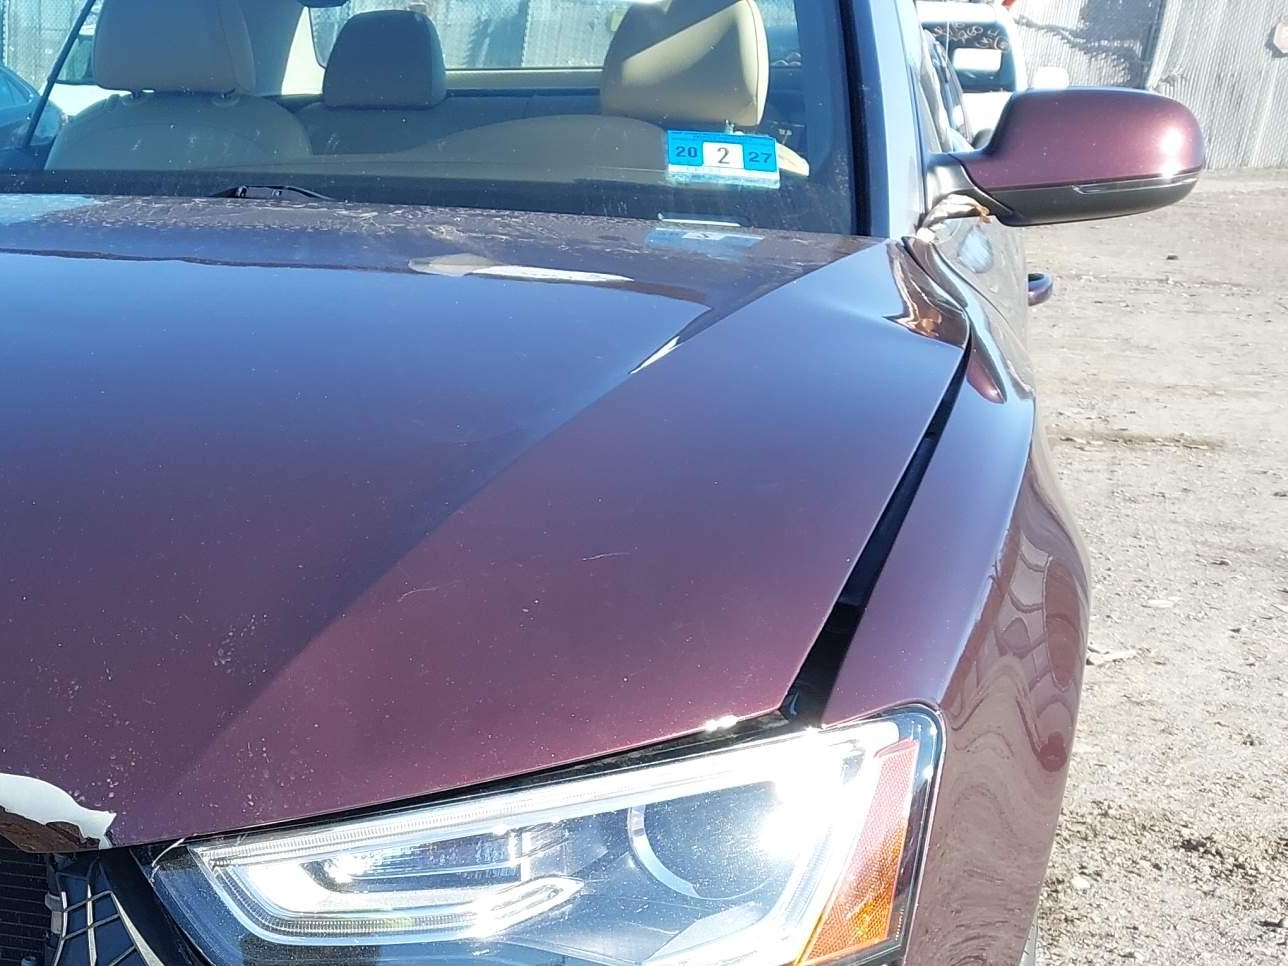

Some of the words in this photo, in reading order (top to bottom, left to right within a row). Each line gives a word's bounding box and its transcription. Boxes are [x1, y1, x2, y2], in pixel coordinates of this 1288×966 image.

[675, 146, 697, 158] 20
[717, 147, 730, 164] 2
[748, 151, 772, 164] 27
